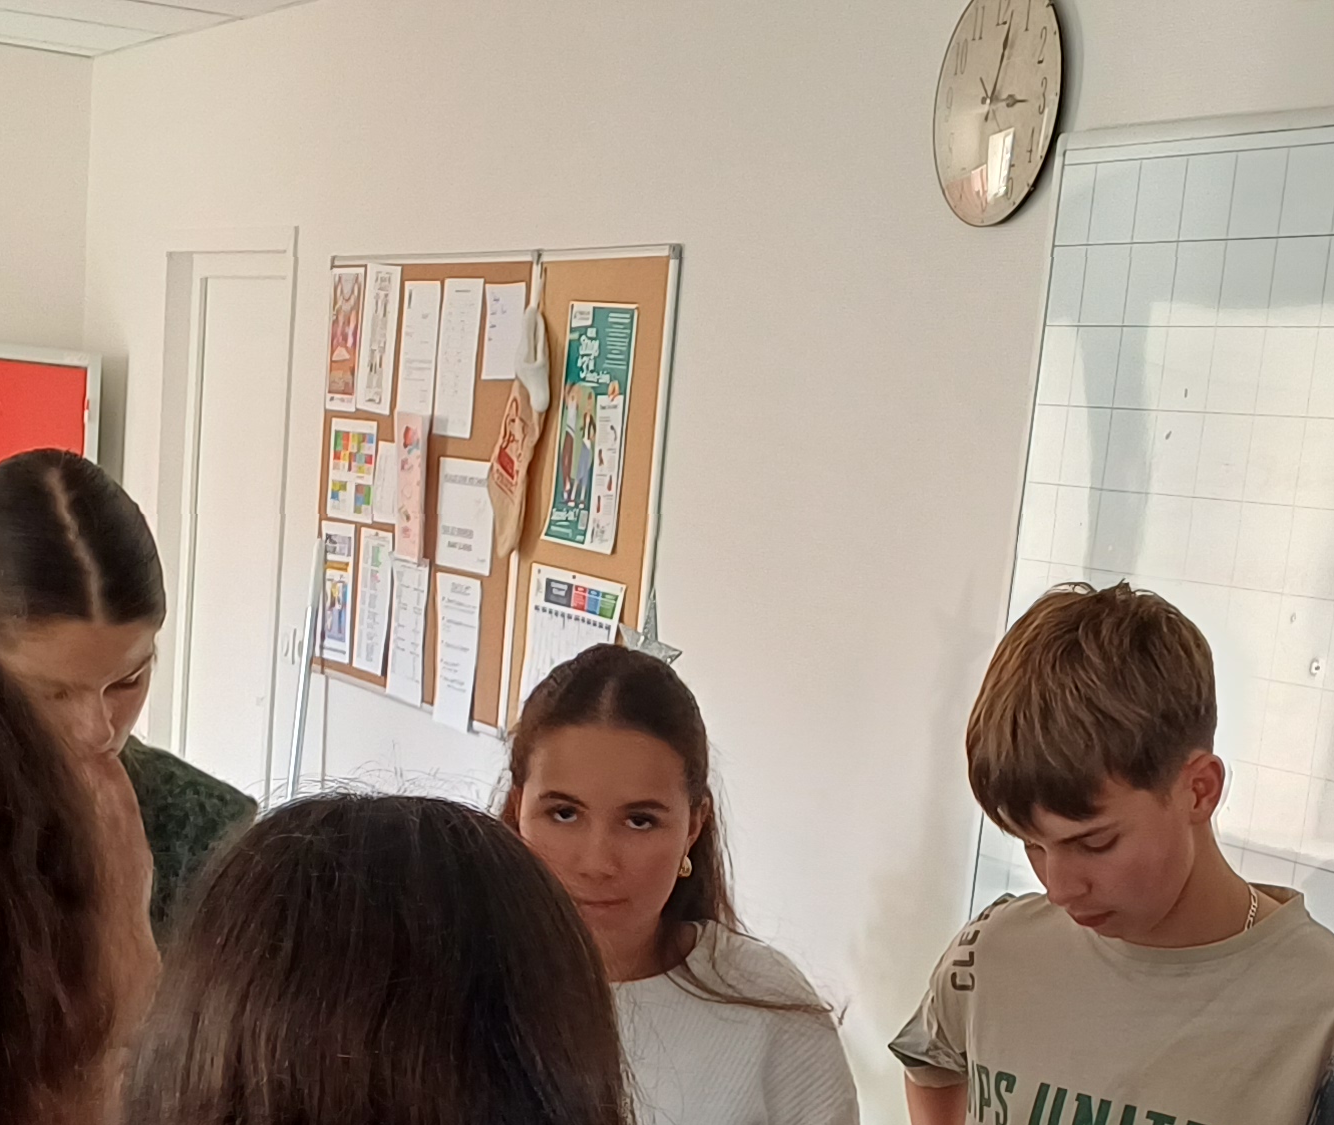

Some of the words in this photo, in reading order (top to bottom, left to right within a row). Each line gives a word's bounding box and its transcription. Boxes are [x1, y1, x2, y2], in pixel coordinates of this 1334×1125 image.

[971, 5, 985, 41] 11
[953, 38, 969, 77] 10
[1037, 25, 1048, 65] 2
[1038, 76, 1048, 116] 3
